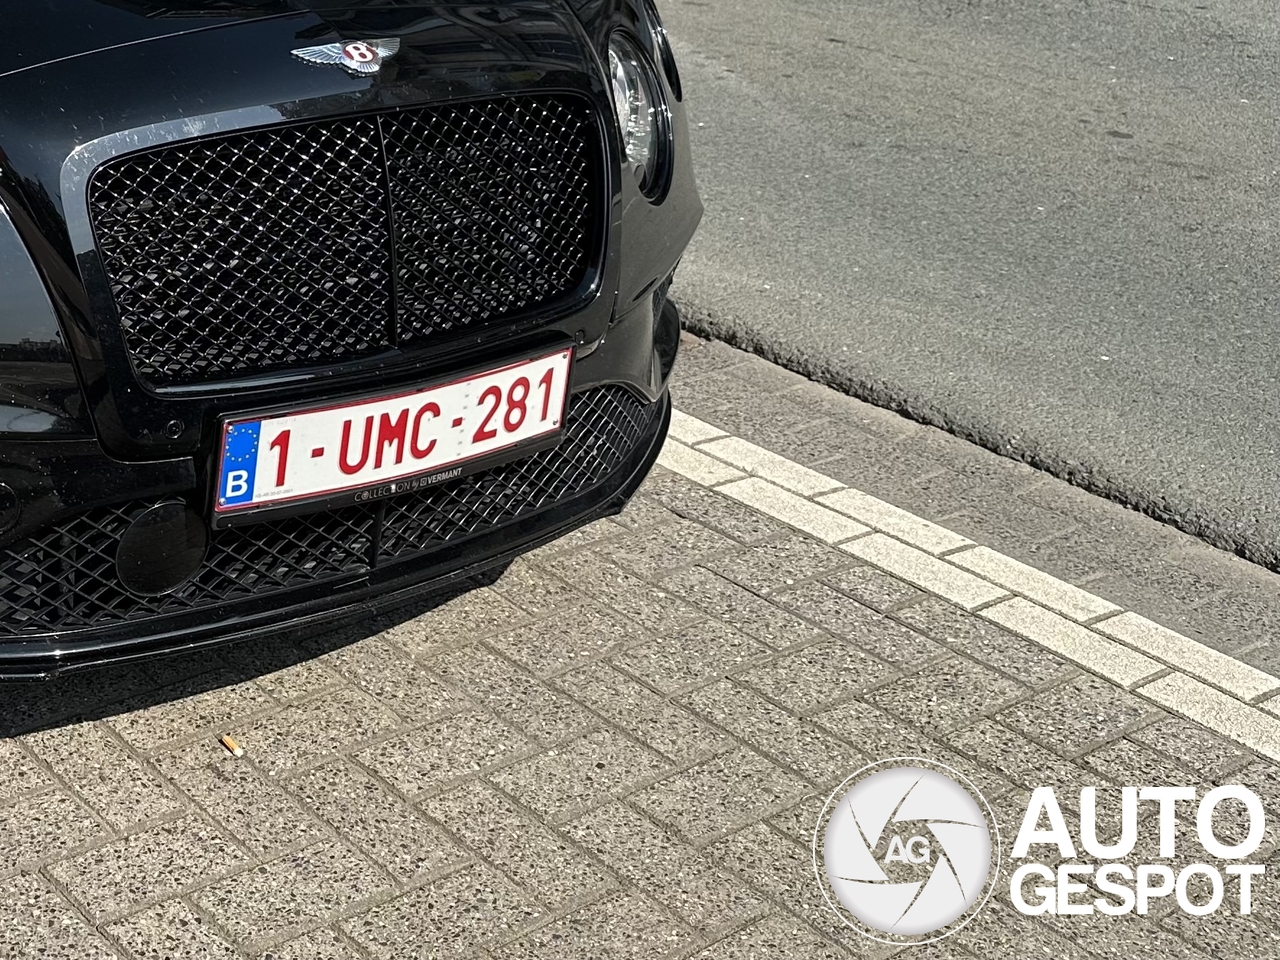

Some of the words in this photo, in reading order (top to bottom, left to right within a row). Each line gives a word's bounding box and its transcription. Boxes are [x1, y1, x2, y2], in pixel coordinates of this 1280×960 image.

[270, 367, 554, 487] 1-UMC-281
[225, 470, 248, 498] B
[354, 481, 411, 502] COLLECTION
[427, 467, 462, 484] VERMANT
